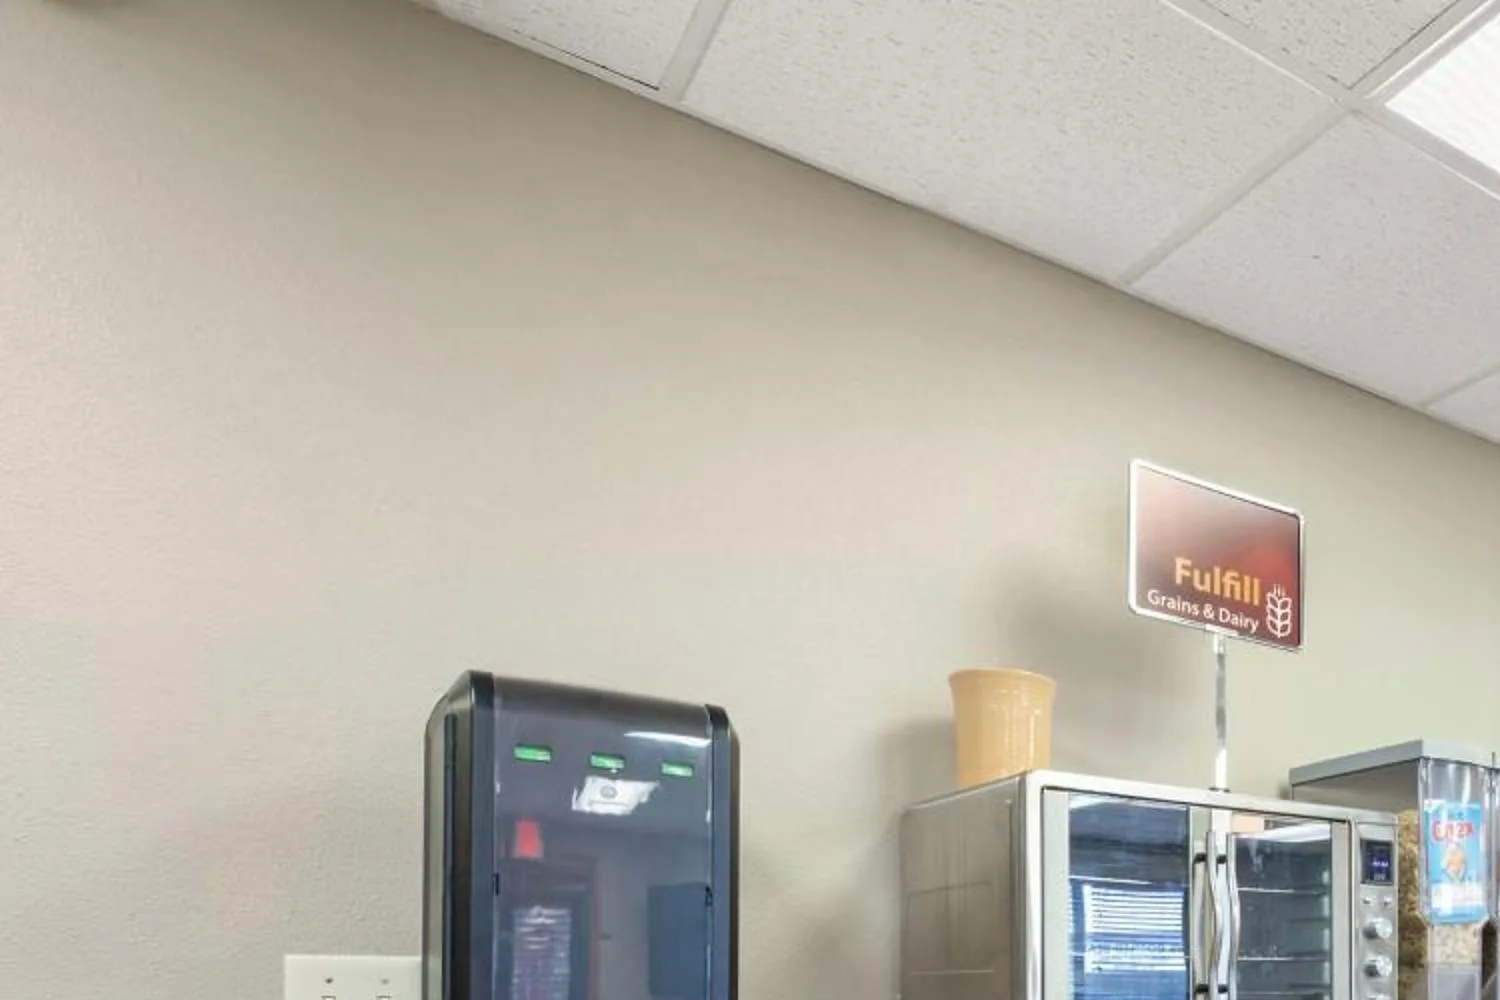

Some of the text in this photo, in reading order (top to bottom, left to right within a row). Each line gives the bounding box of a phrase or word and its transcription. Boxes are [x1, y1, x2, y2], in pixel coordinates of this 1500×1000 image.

[1174, 556, 1261, 606] Fulfill
[1147, 589, 1260, 633] Grains & Dairy
